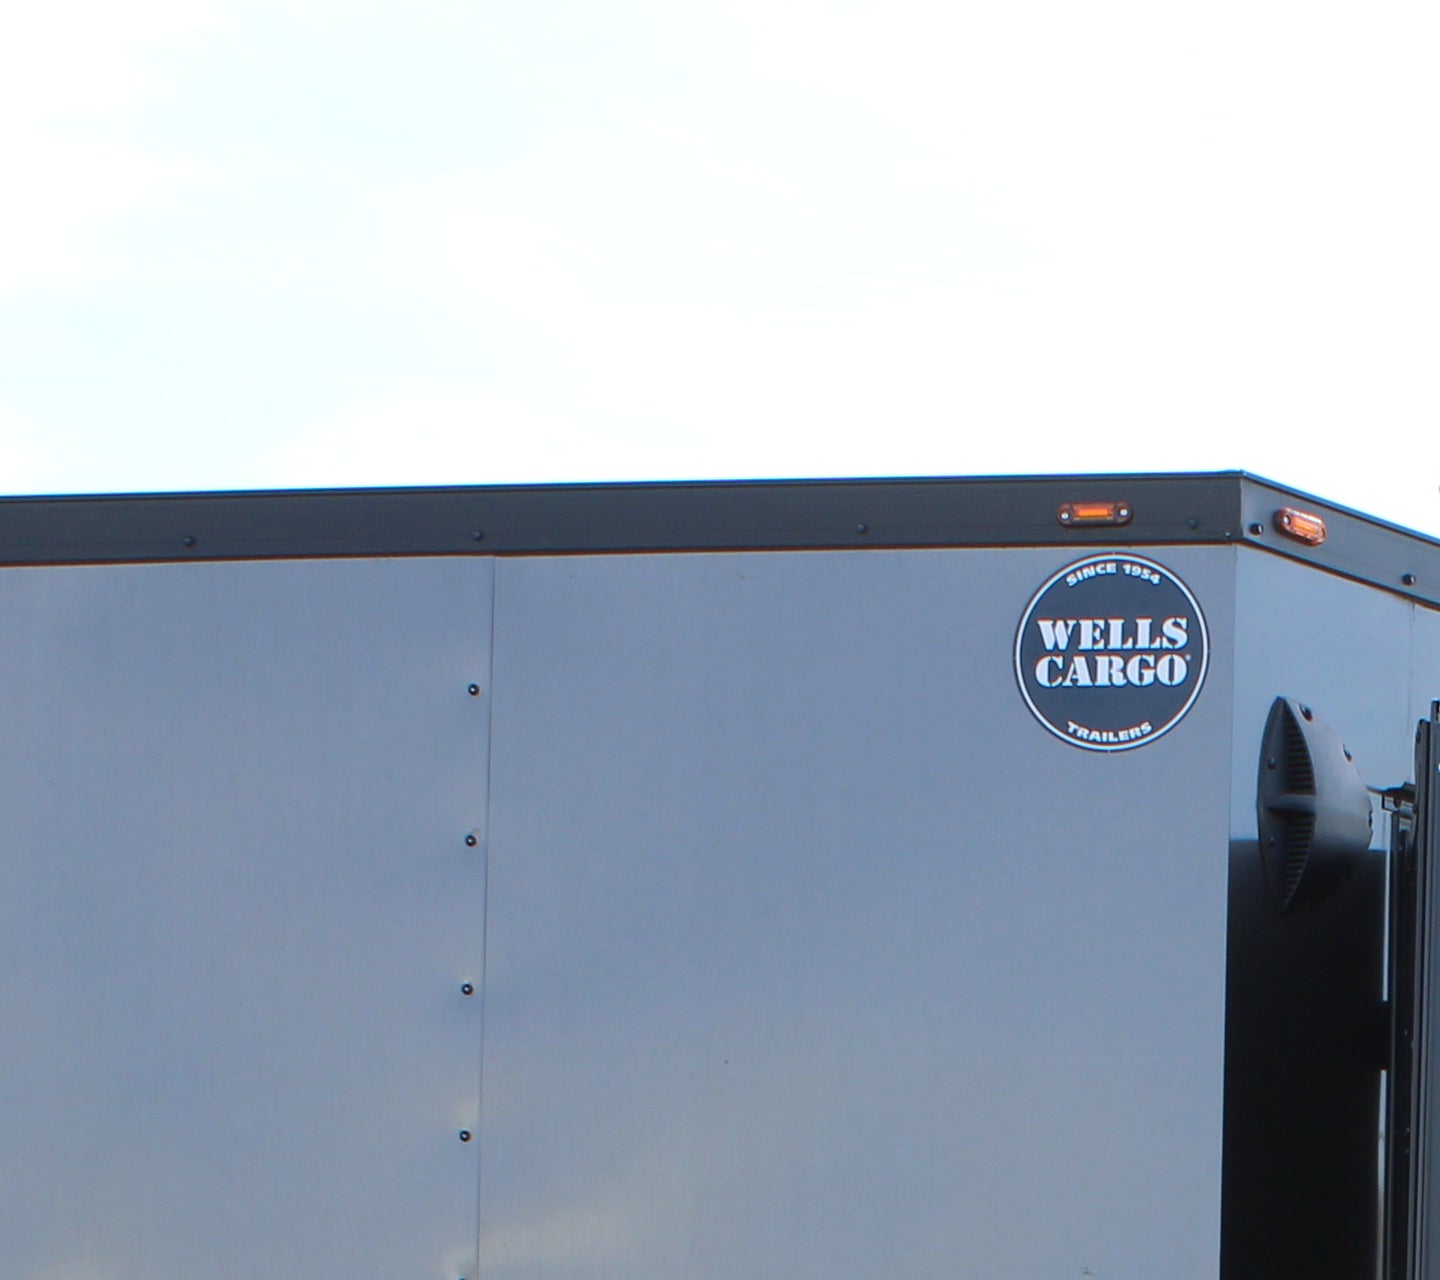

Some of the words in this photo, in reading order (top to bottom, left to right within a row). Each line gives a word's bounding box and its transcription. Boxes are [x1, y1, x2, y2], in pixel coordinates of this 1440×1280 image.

[1066, 562, 1117, 587] SINCE
[1122, 563, 1161, 586] 1954
[1037, 617, 1189, 651] WELLS
[1035, 653, 1189, 687] CARGO
[1066, 720, 1153, 743] TRAILERS
